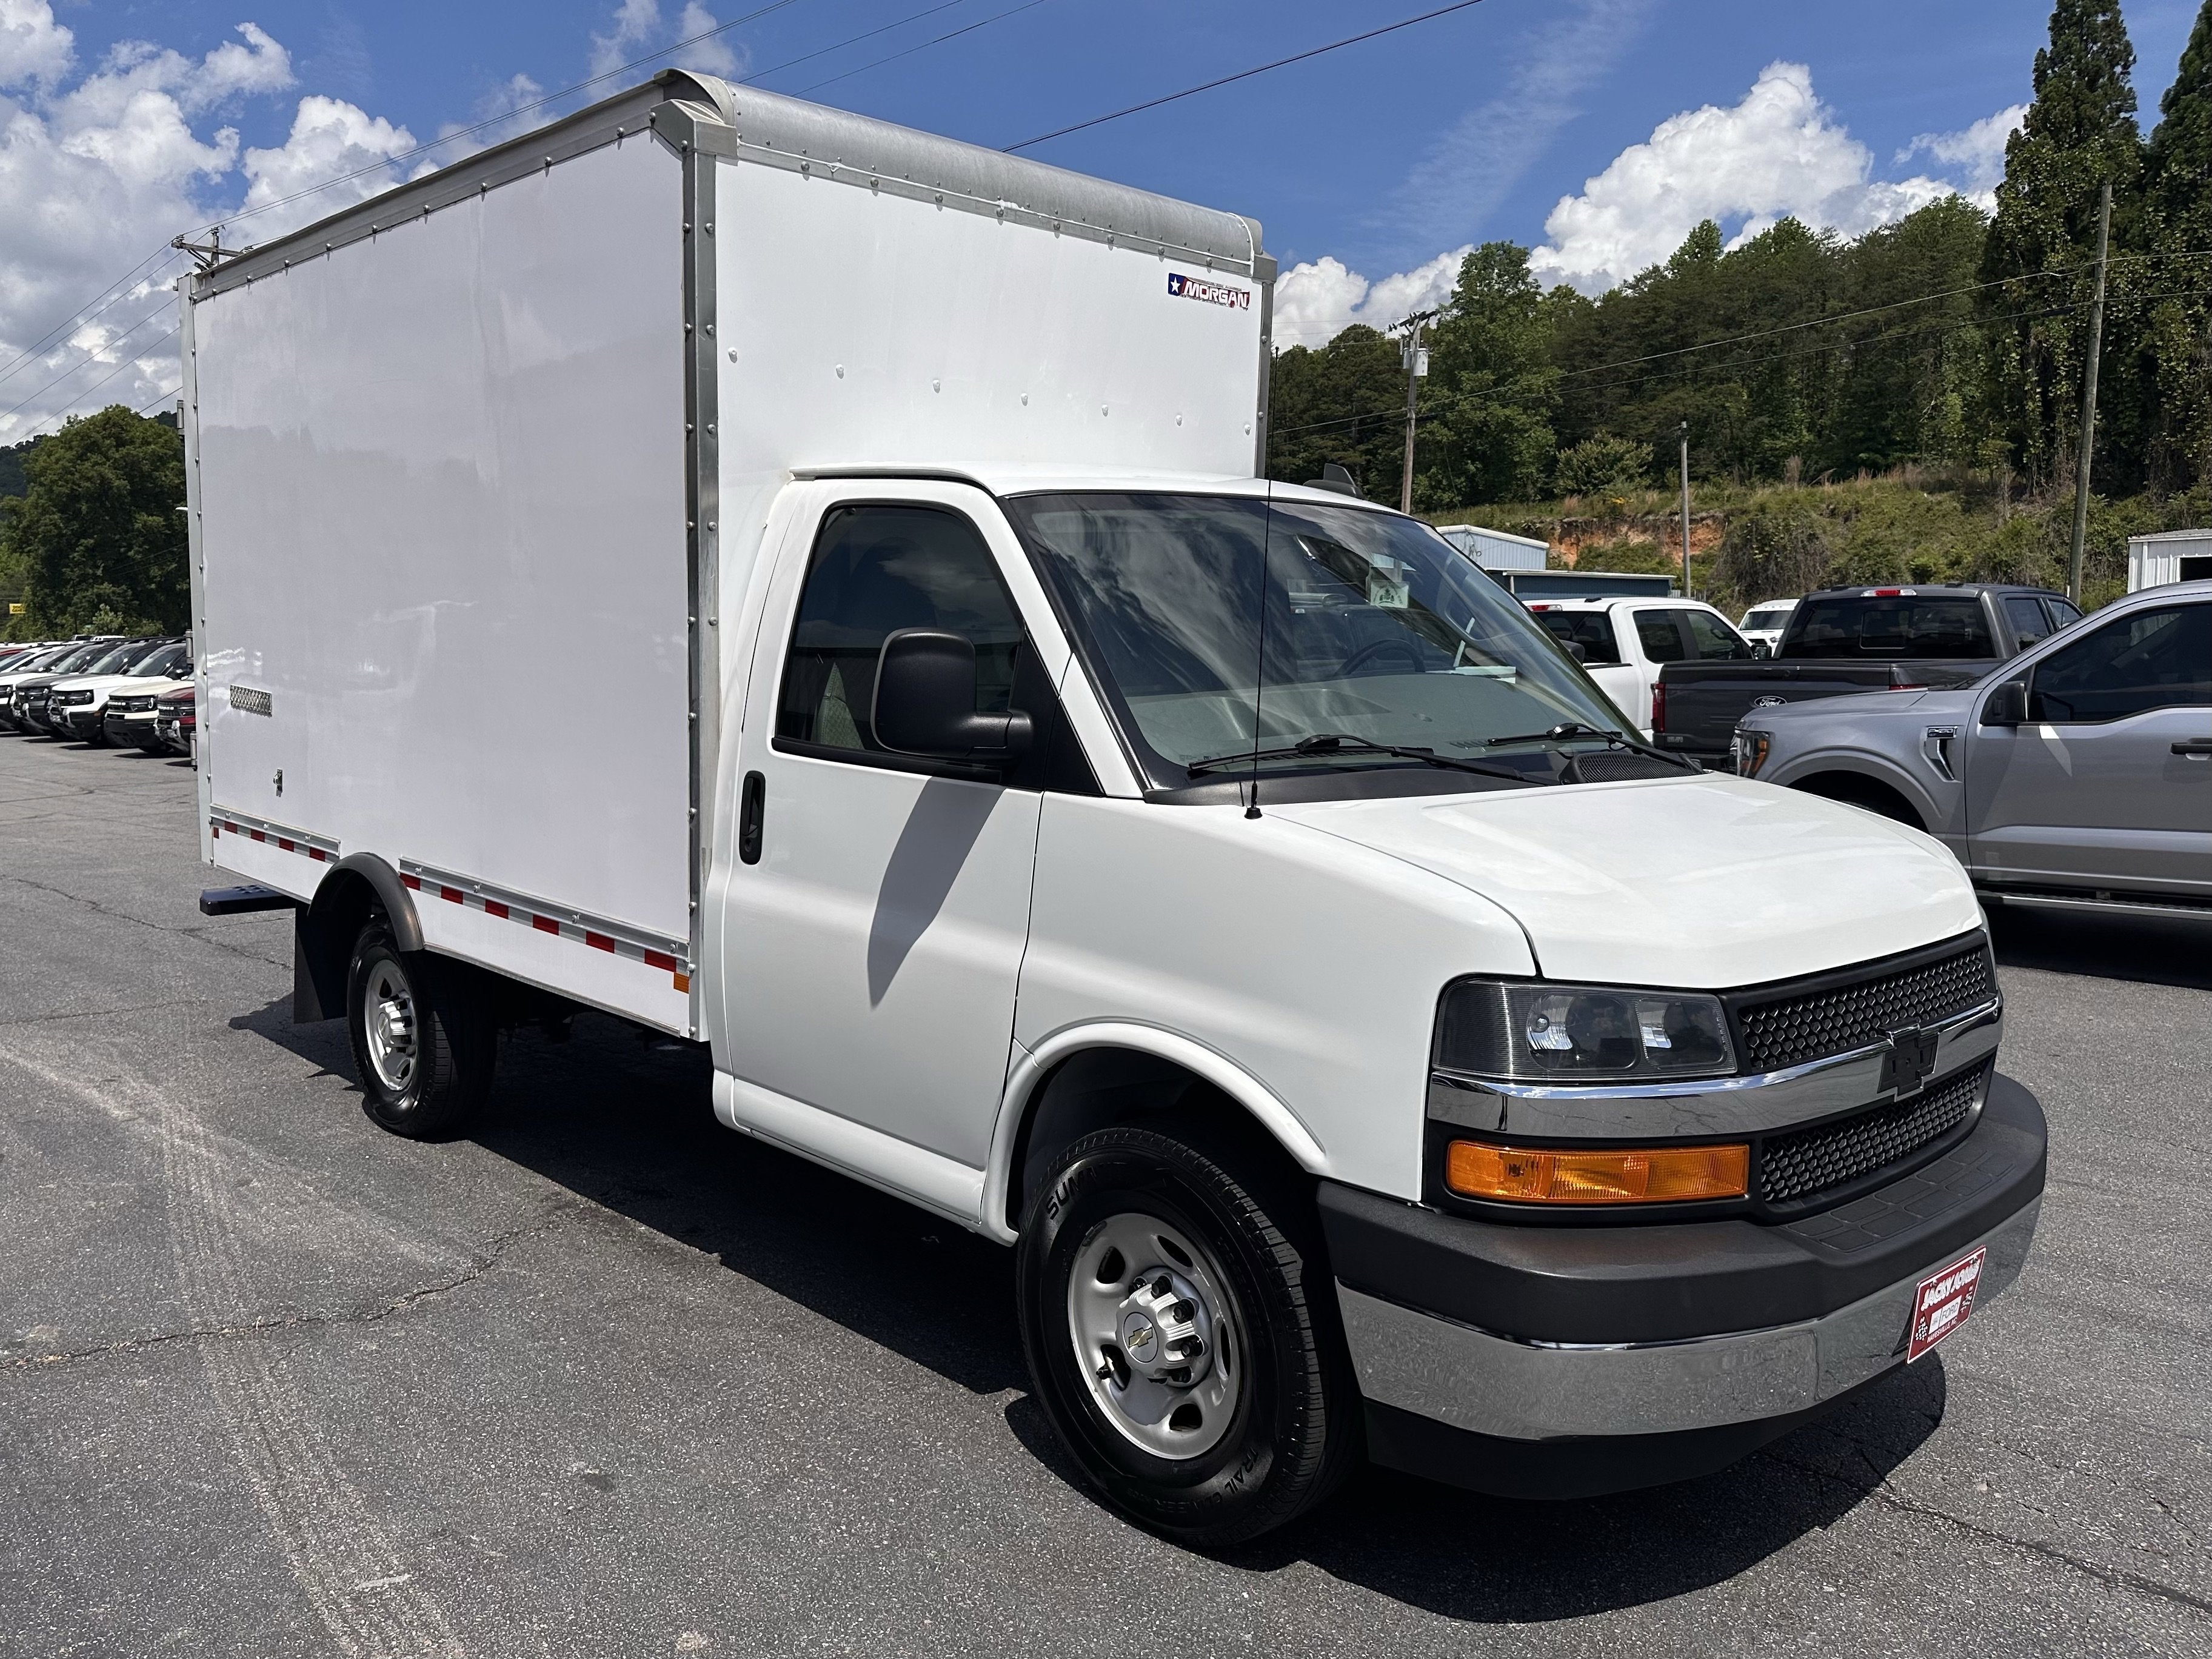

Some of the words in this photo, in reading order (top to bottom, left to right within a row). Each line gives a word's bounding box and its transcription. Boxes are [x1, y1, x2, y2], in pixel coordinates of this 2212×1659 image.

[1183, 281, 1248, 309] MORGAN
[1759, 697, 1782, 707] Ford
[1920, 1273, 1955, 1312] JACKY
[1950, 1258, 1981, 1294] JONES
[1941, 1301, 1959, 1321] FORD
